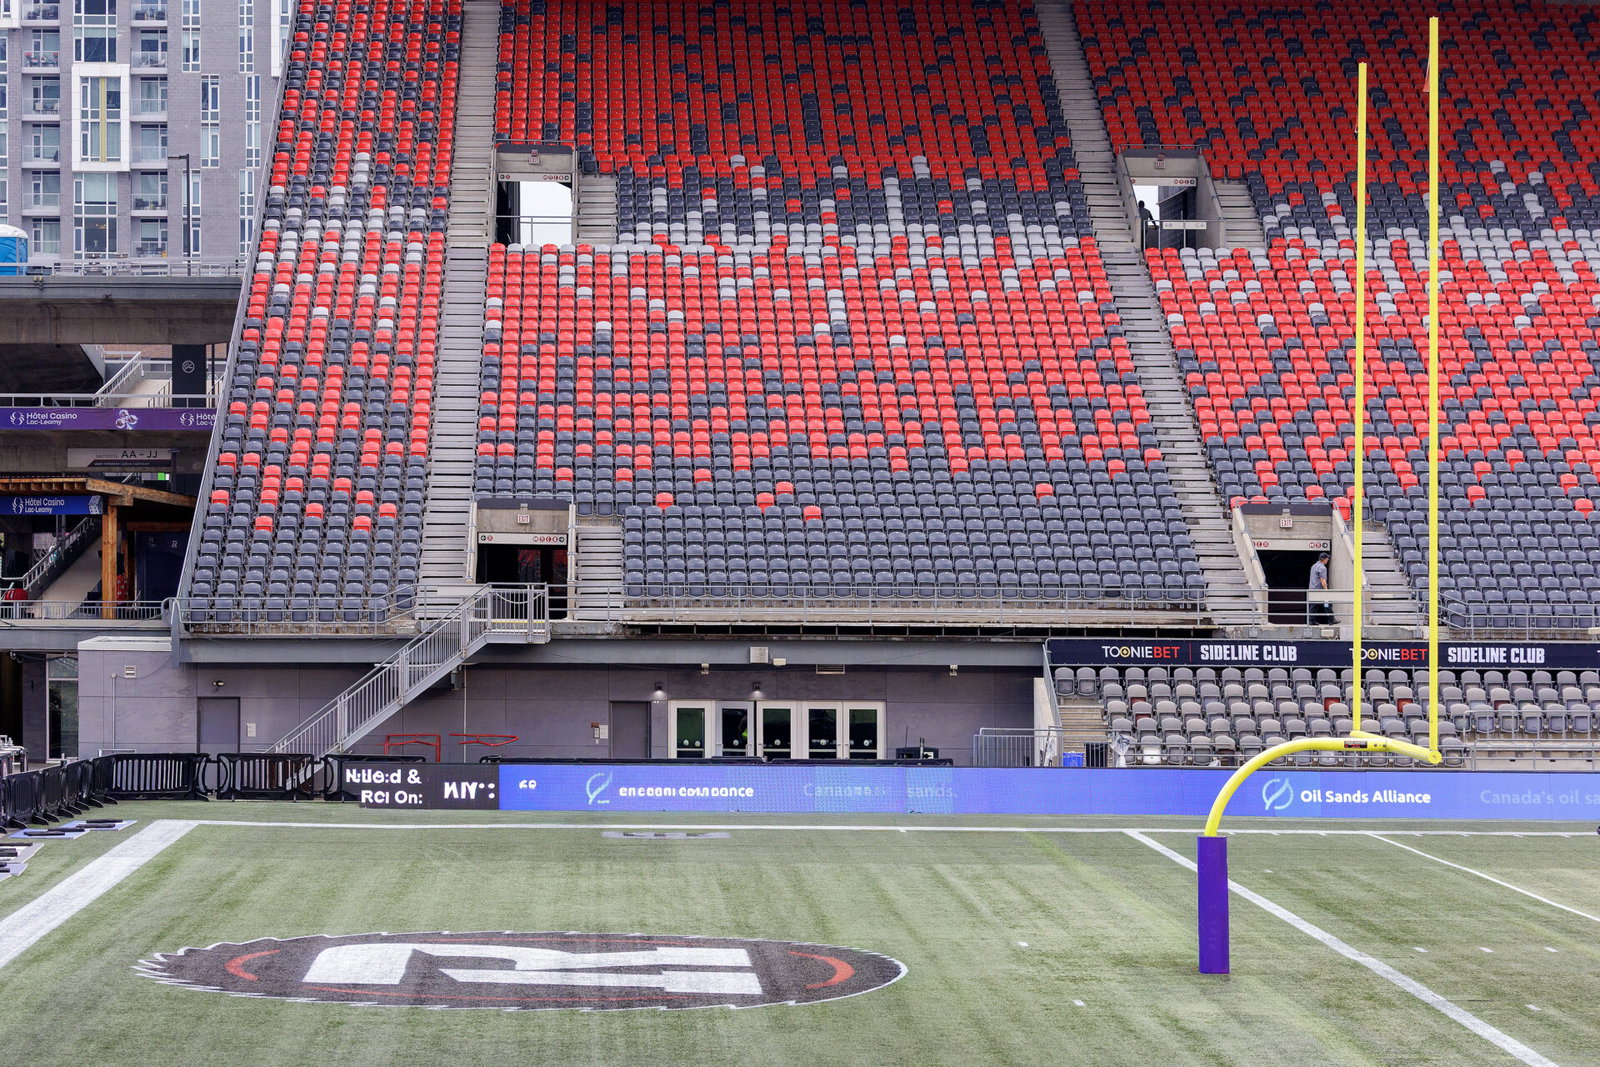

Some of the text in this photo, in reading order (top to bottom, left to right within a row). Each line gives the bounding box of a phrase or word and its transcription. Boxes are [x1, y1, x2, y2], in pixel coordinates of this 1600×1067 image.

[26, 412, 78, 420] Hôtel Casino
[121, 450, 137, 459] AA
[146, 450, 158, 459] JJ
[24, 497, 65, 506] Hôtel Casino
[1101, 644, 1298, 662] TOONIEBET SIDELINE CLUB
[1447, 647, 1507, 663] SIDELINE
[1510, 648, 1546, 664] CLUB
[1300, 789, 1431, 804] Oil Sands Alliance
[1480, 790, 1554, 805] Canada's
[1559, 790, 1580, 805] oil
